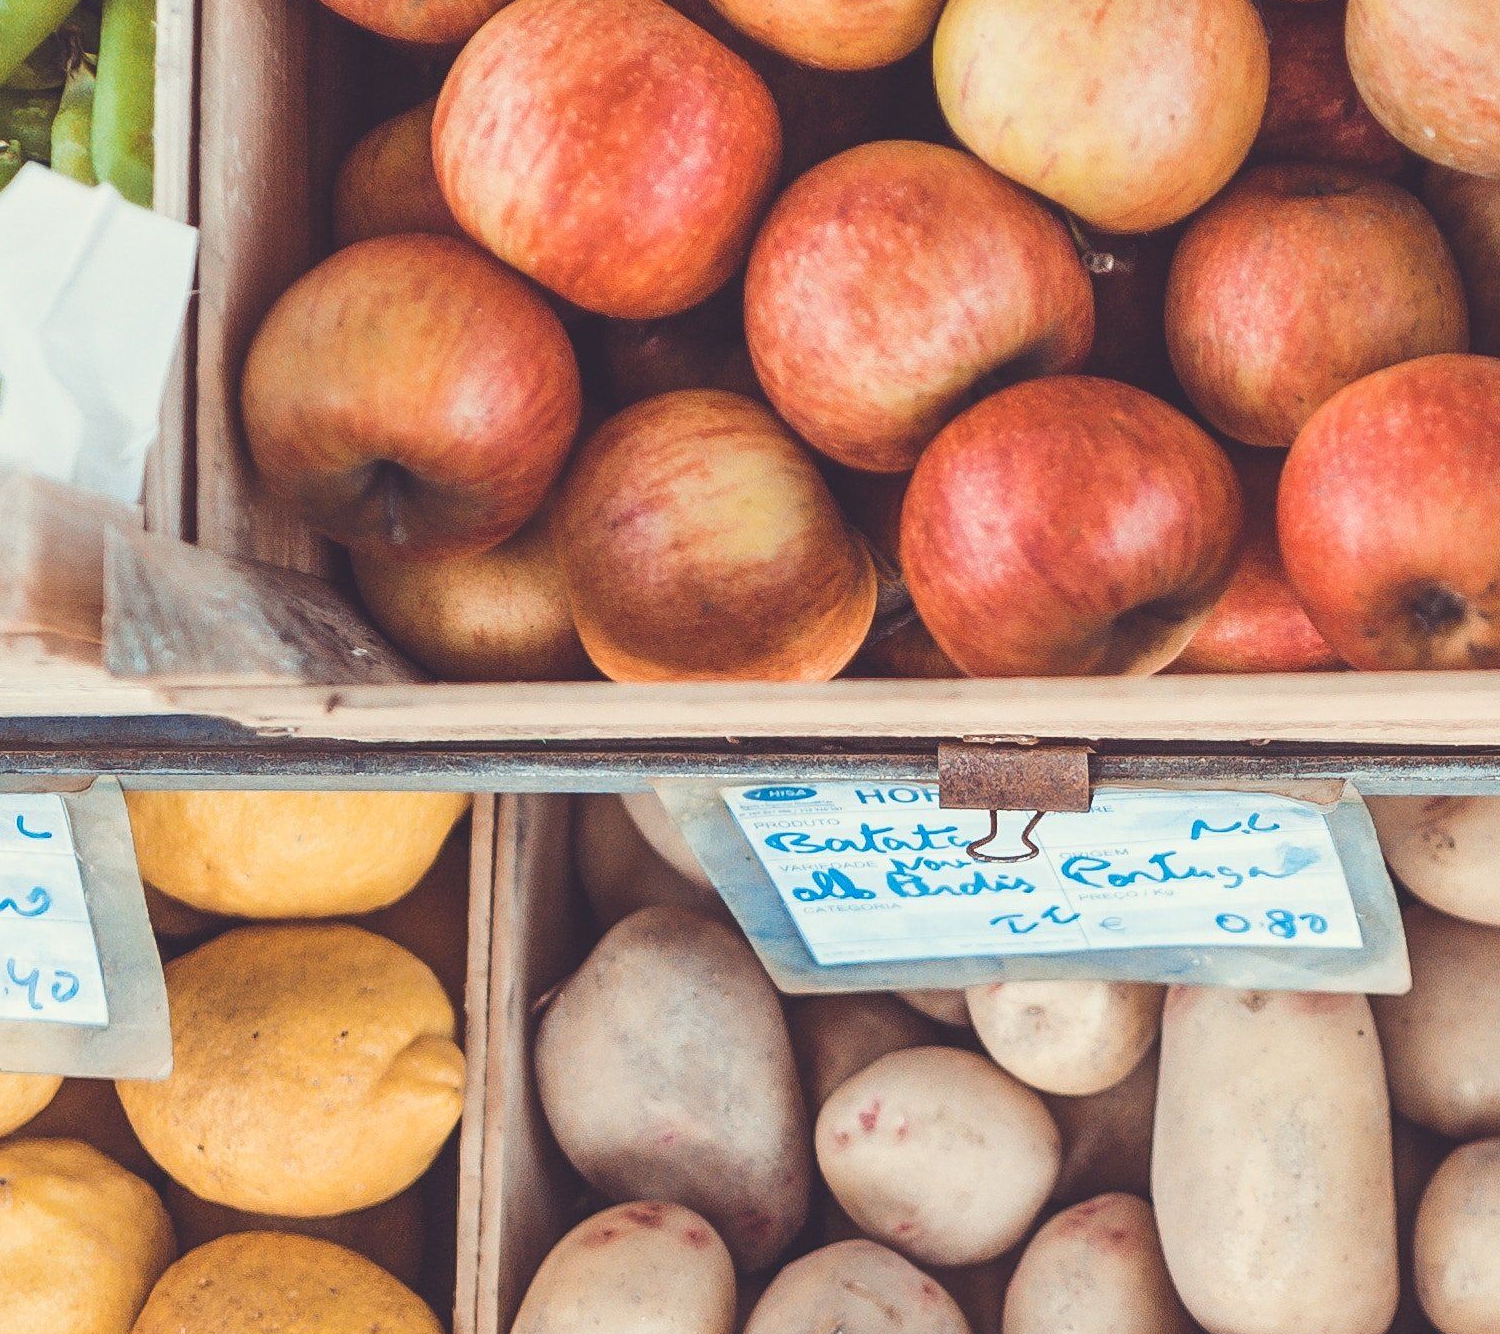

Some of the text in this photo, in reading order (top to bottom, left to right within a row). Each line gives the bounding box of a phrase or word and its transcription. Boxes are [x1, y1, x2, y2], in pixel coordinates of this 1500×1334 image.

[754, 817, 840, 830] PRODUTO
[779, 859, 877, 871] VARIEDADE
[803, 902, 902, 914] CATEGORIA
[1099, 917, 1125, 930] €
